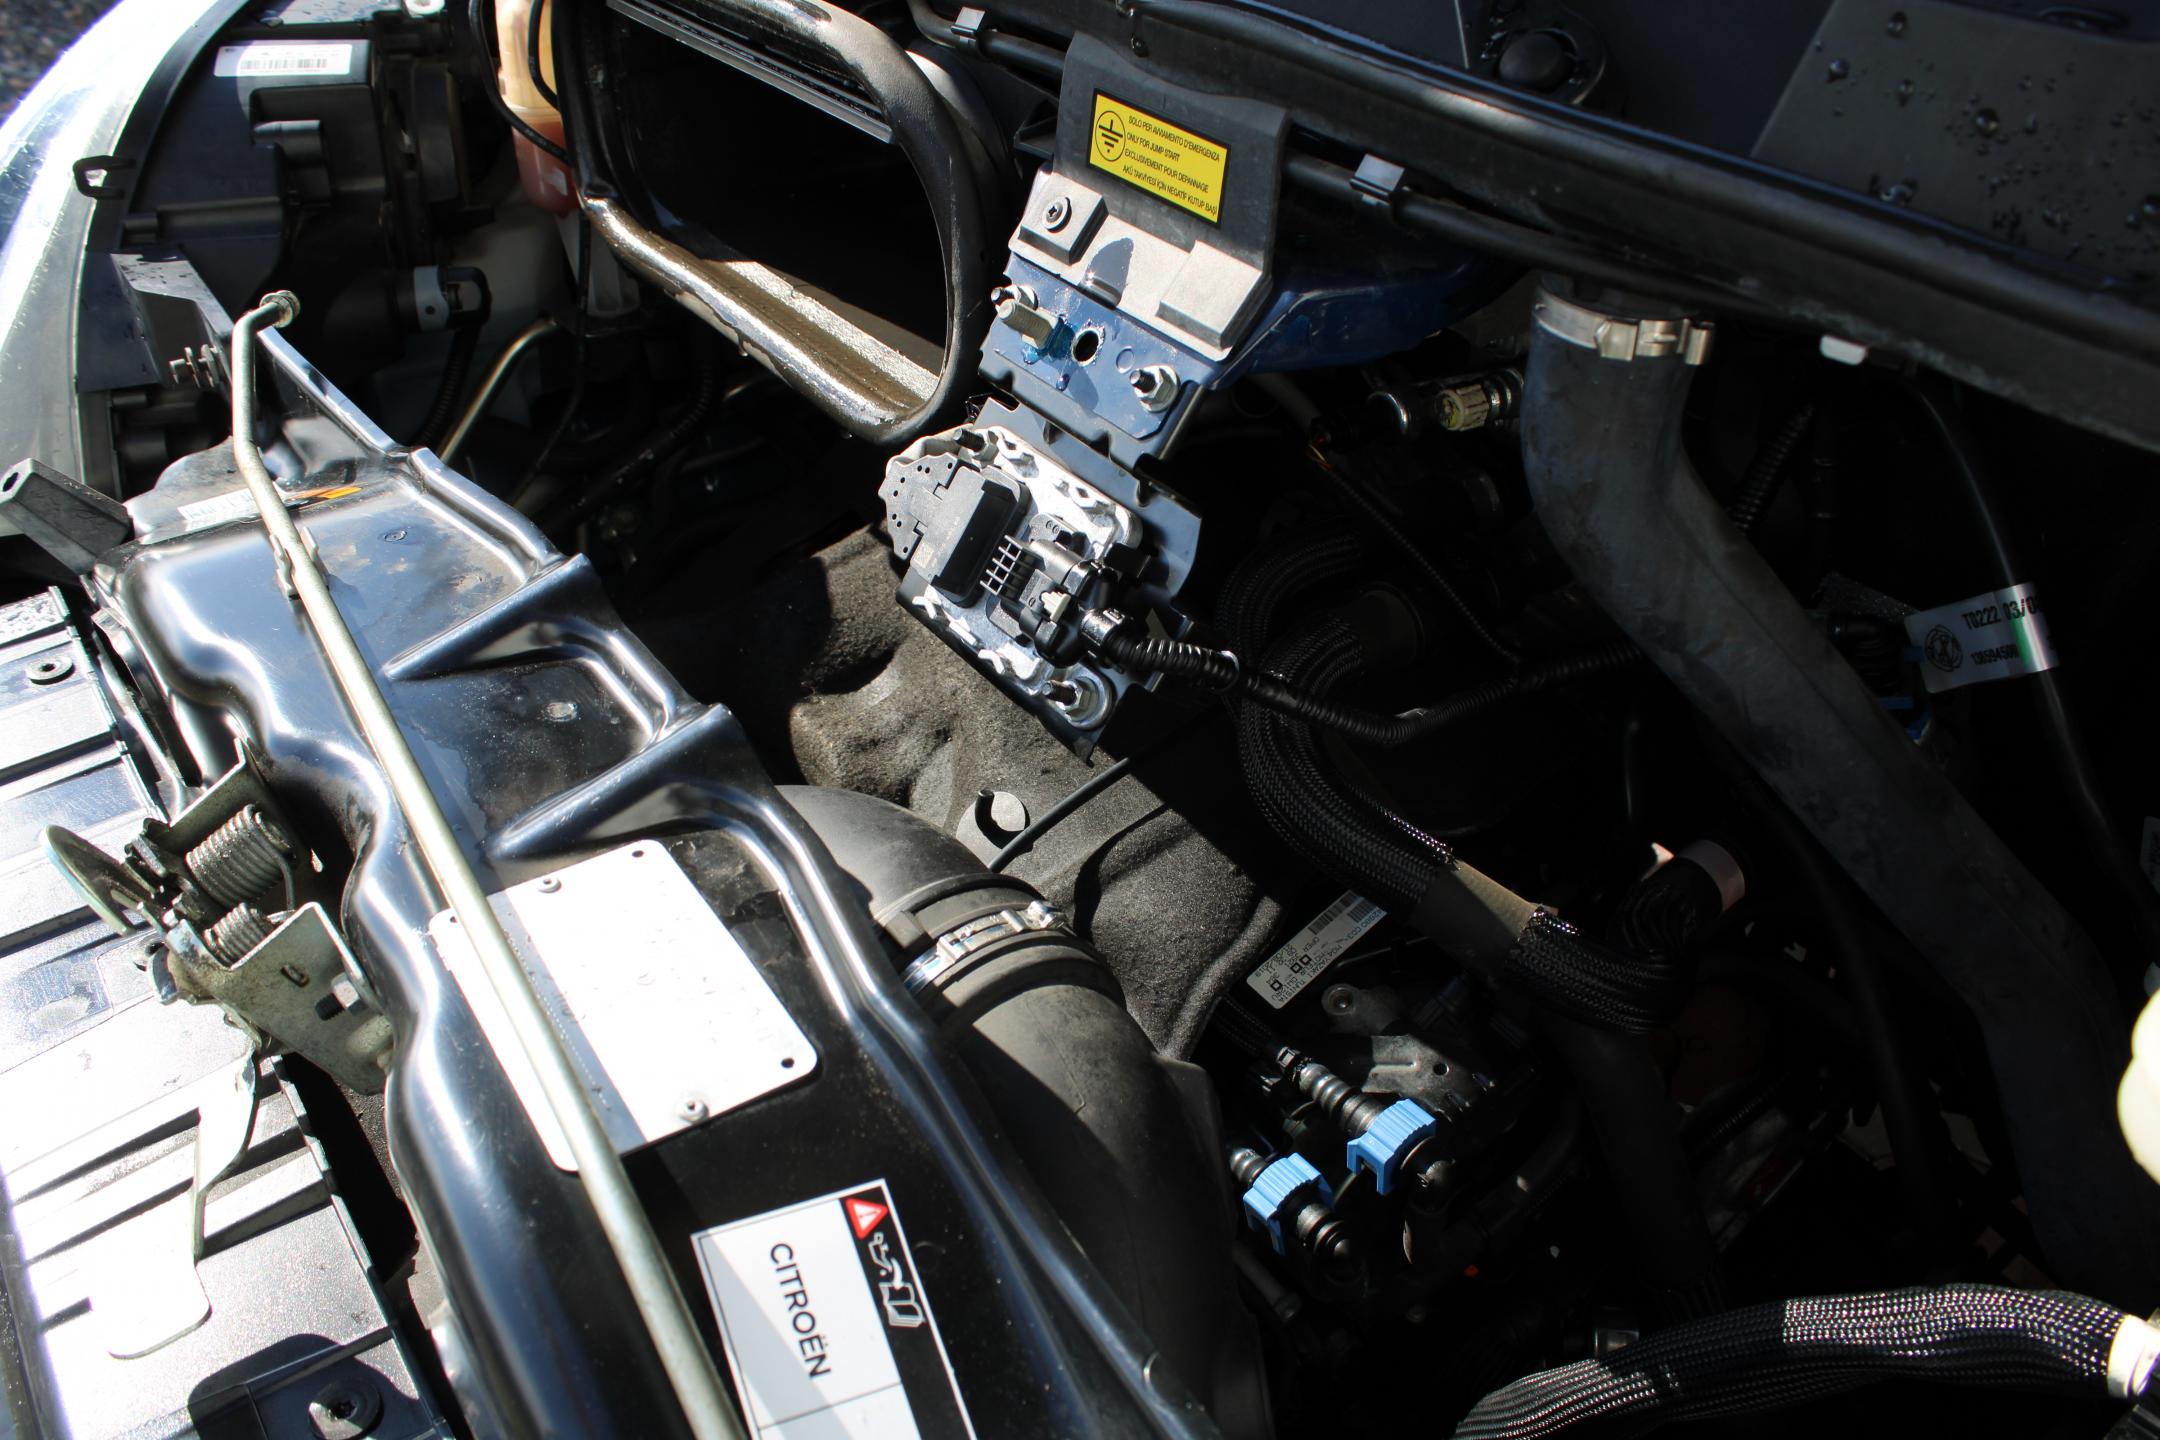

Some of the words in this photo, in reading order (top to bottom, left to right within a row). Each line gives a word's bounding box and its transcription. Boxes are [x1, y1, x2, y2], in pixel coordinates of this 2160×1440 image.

[1126, 131, 1139, 144] ONLY
[1139, 137, 1150, 149] FOR
[1149, 141, 1164, 155] JUMP
[1163, 148, 1180, 163] START
[1128, 114, 1142, 129] SOLO
[1142, 120, 1152, 133] PER
[1152, 125, 1183, 147] AVVIAMENTO
[1124, 147, 1163, 172] EXCLUSIVEMENT
[1163, 165, 1178, 180] POUR
[770, 1243, 832, 1378] CITROËN
